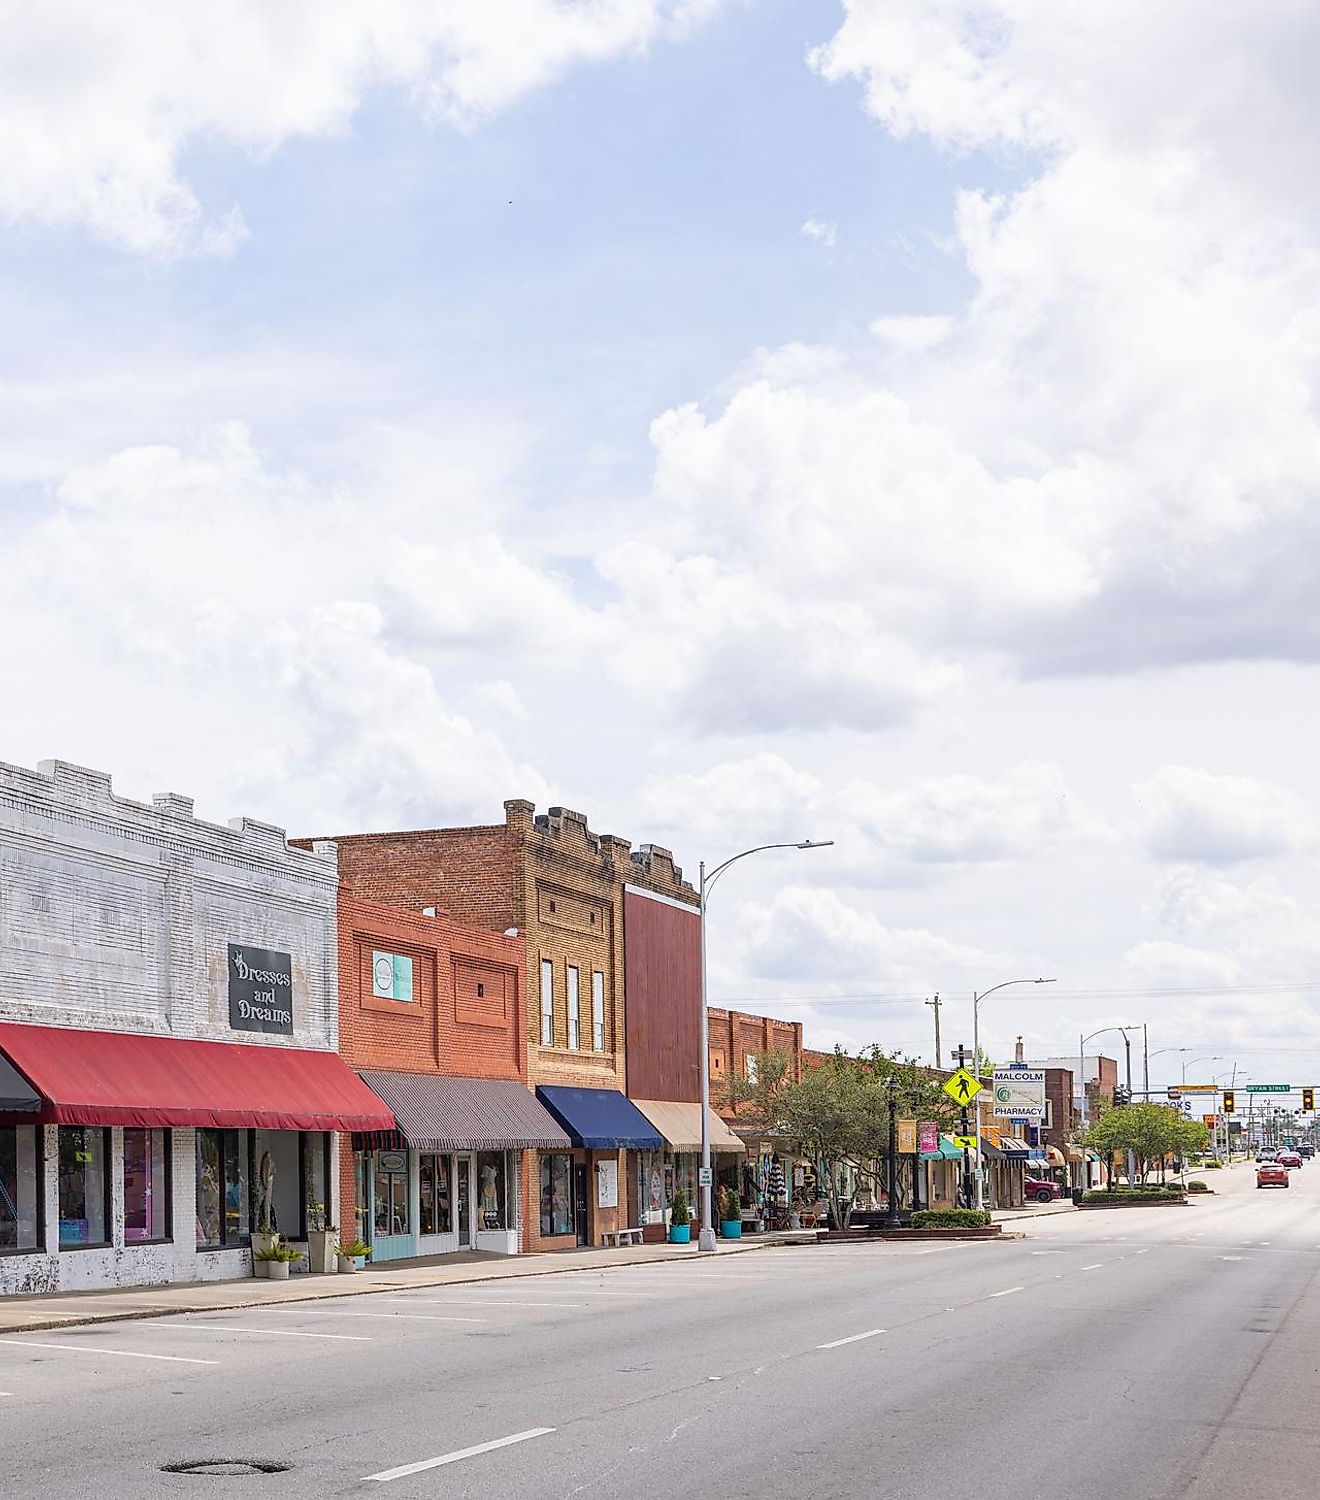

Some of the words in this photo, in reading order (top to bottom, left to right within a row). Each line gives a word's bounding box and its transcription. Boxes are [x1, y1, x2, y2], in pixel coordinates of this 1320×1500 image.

[236, 960, 291, 987] Dresses
[254, 988, 276, 1005] and
[238, 999, 291, 1026] Dreams
[994, 1072, 1043, 1081] MALCOLM
[994, 1107, 1043, 1115] PHARMACY
